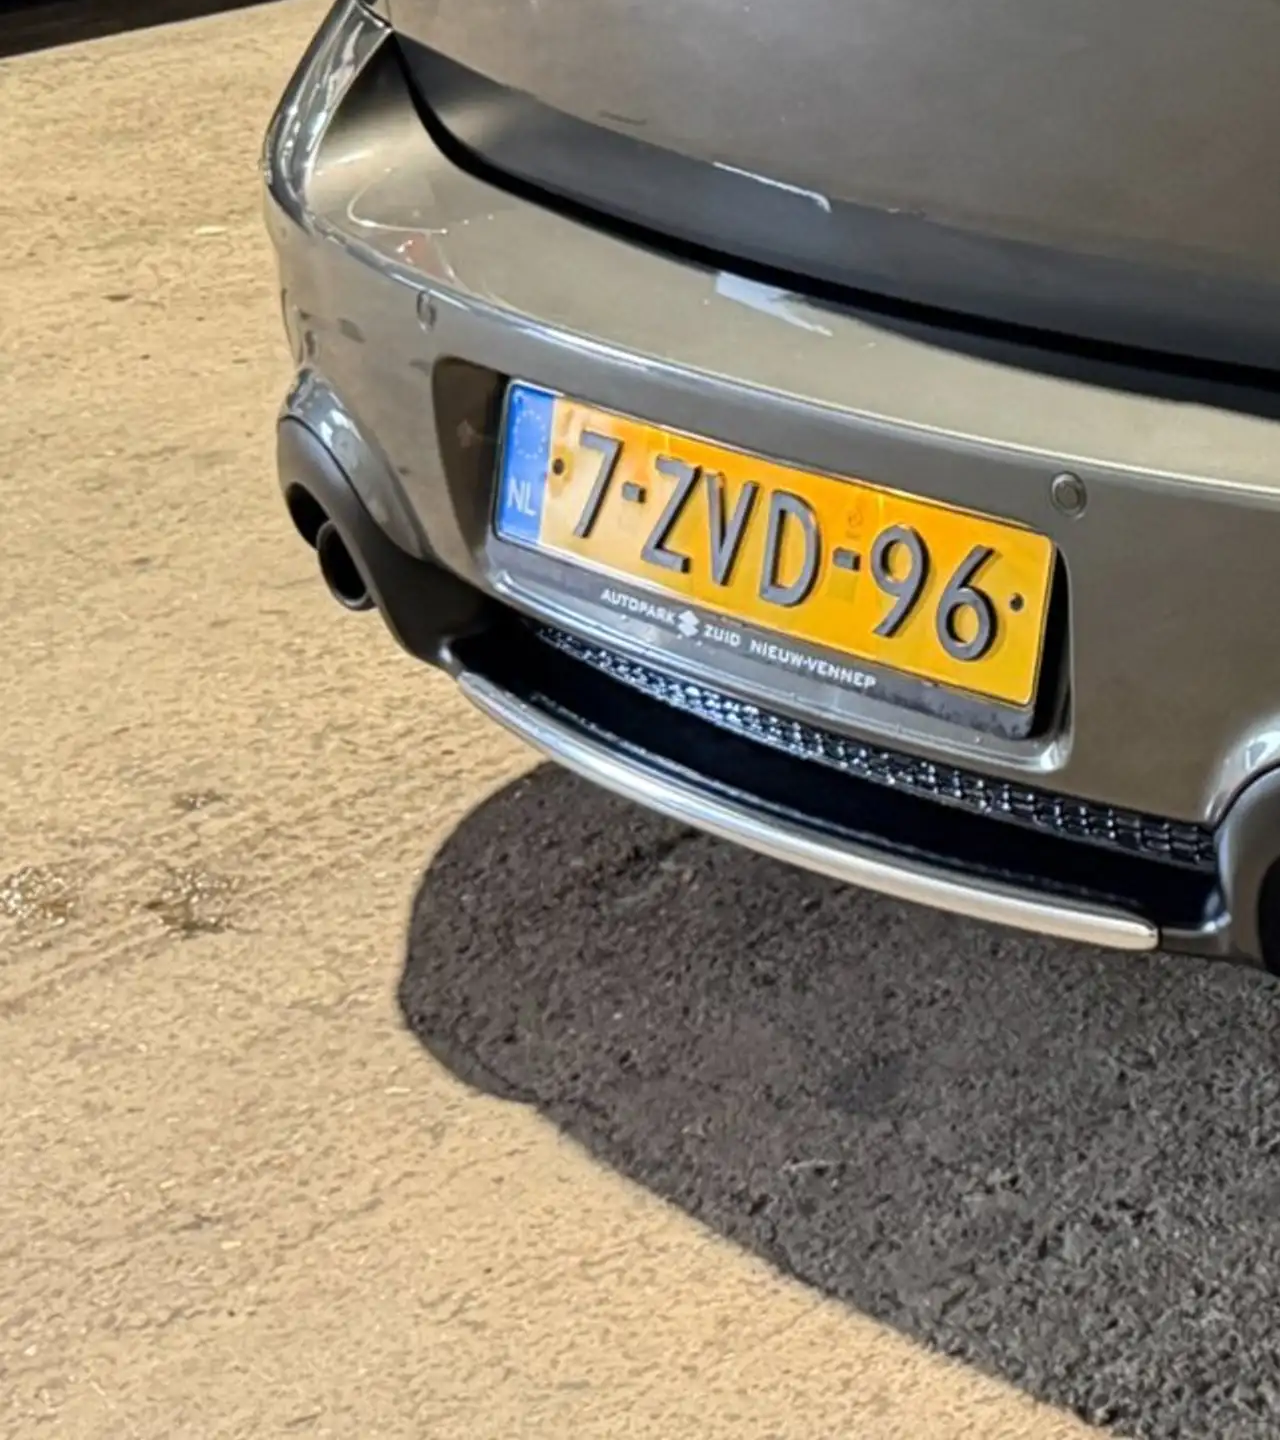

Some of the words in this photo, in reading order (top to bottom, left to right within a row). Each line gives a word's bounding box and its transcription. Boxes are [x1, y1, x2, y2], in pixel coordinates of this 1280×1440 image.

[506, 476, 537, 518] NL
[572, 427, 999, 662] 7-ZVD-96
[600, 588, 676, 625] AUTOPARK
[702, 623, 742, 649] ZUID
[749, 639, 878, 690] NIEUW-VENNEP
